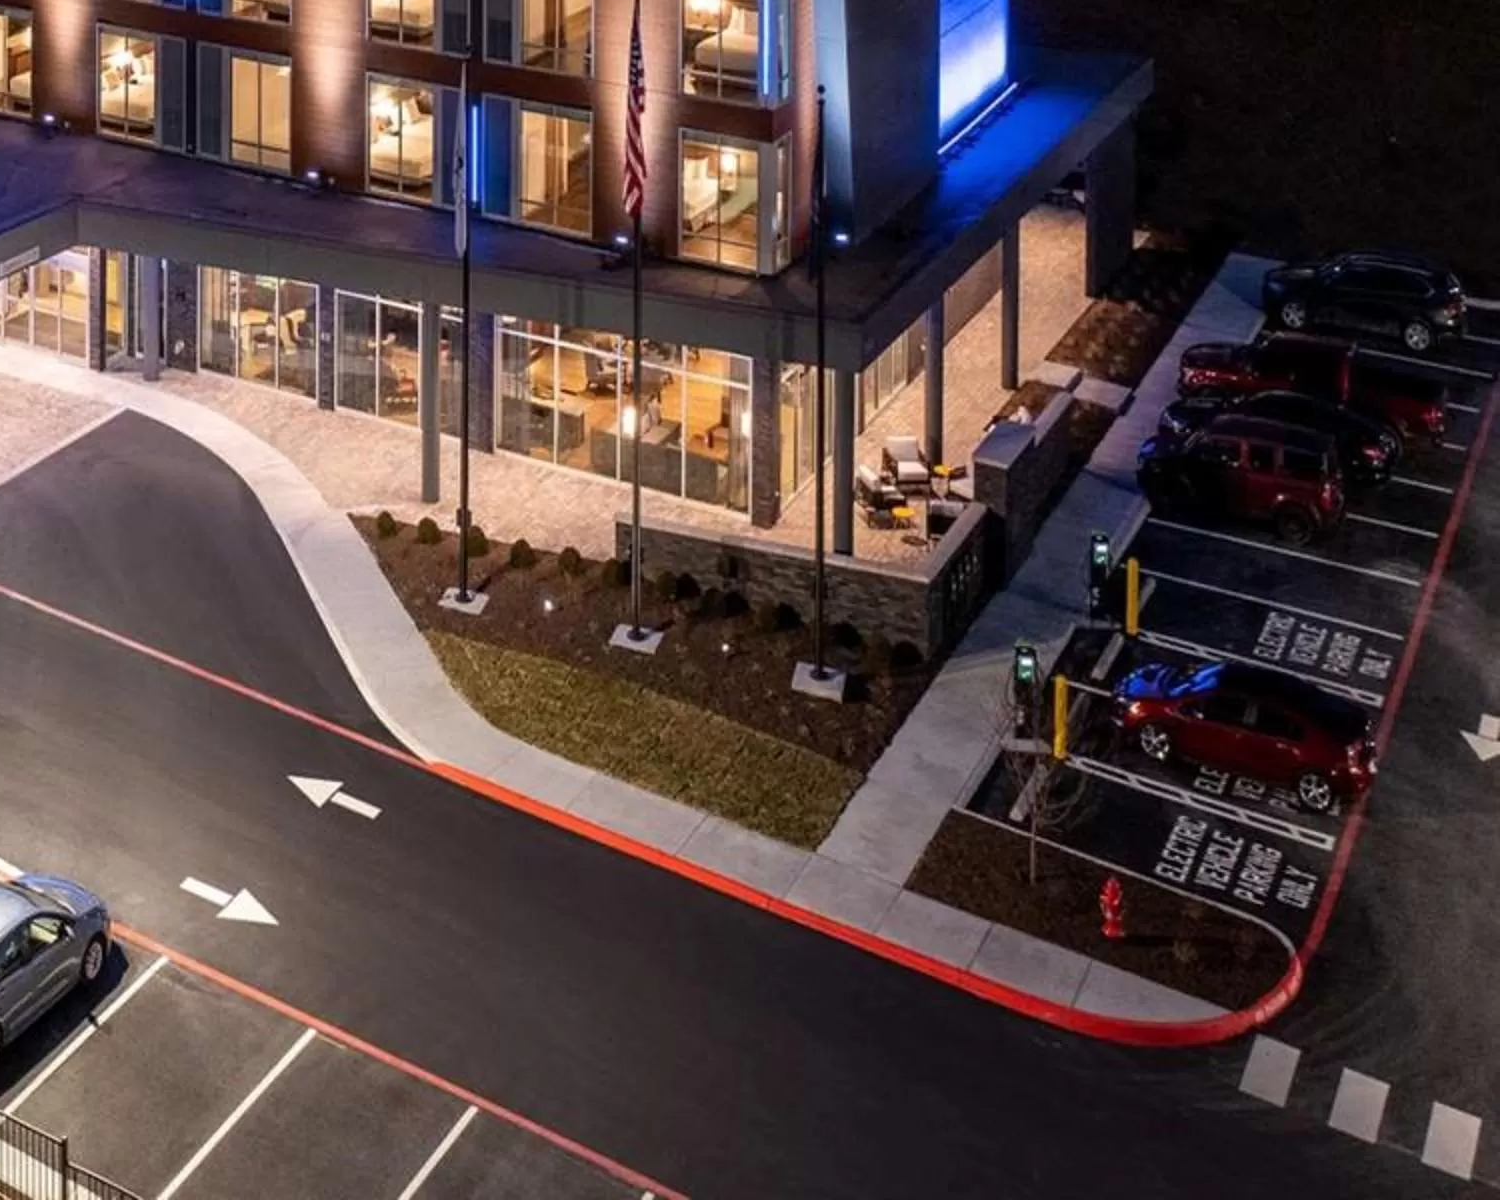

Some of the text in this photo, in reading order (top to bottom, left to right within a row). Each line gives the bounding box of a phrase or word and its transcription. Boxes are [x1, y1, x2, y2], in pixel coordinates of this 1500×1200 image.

[1153, 815, 1208, 883] ELECTRIC
[1193, 830, 1245, 891] VEHICLE
[1232, 842, 1284, 906] PARKING
[1274, 864, 1319, 909] ONLY
